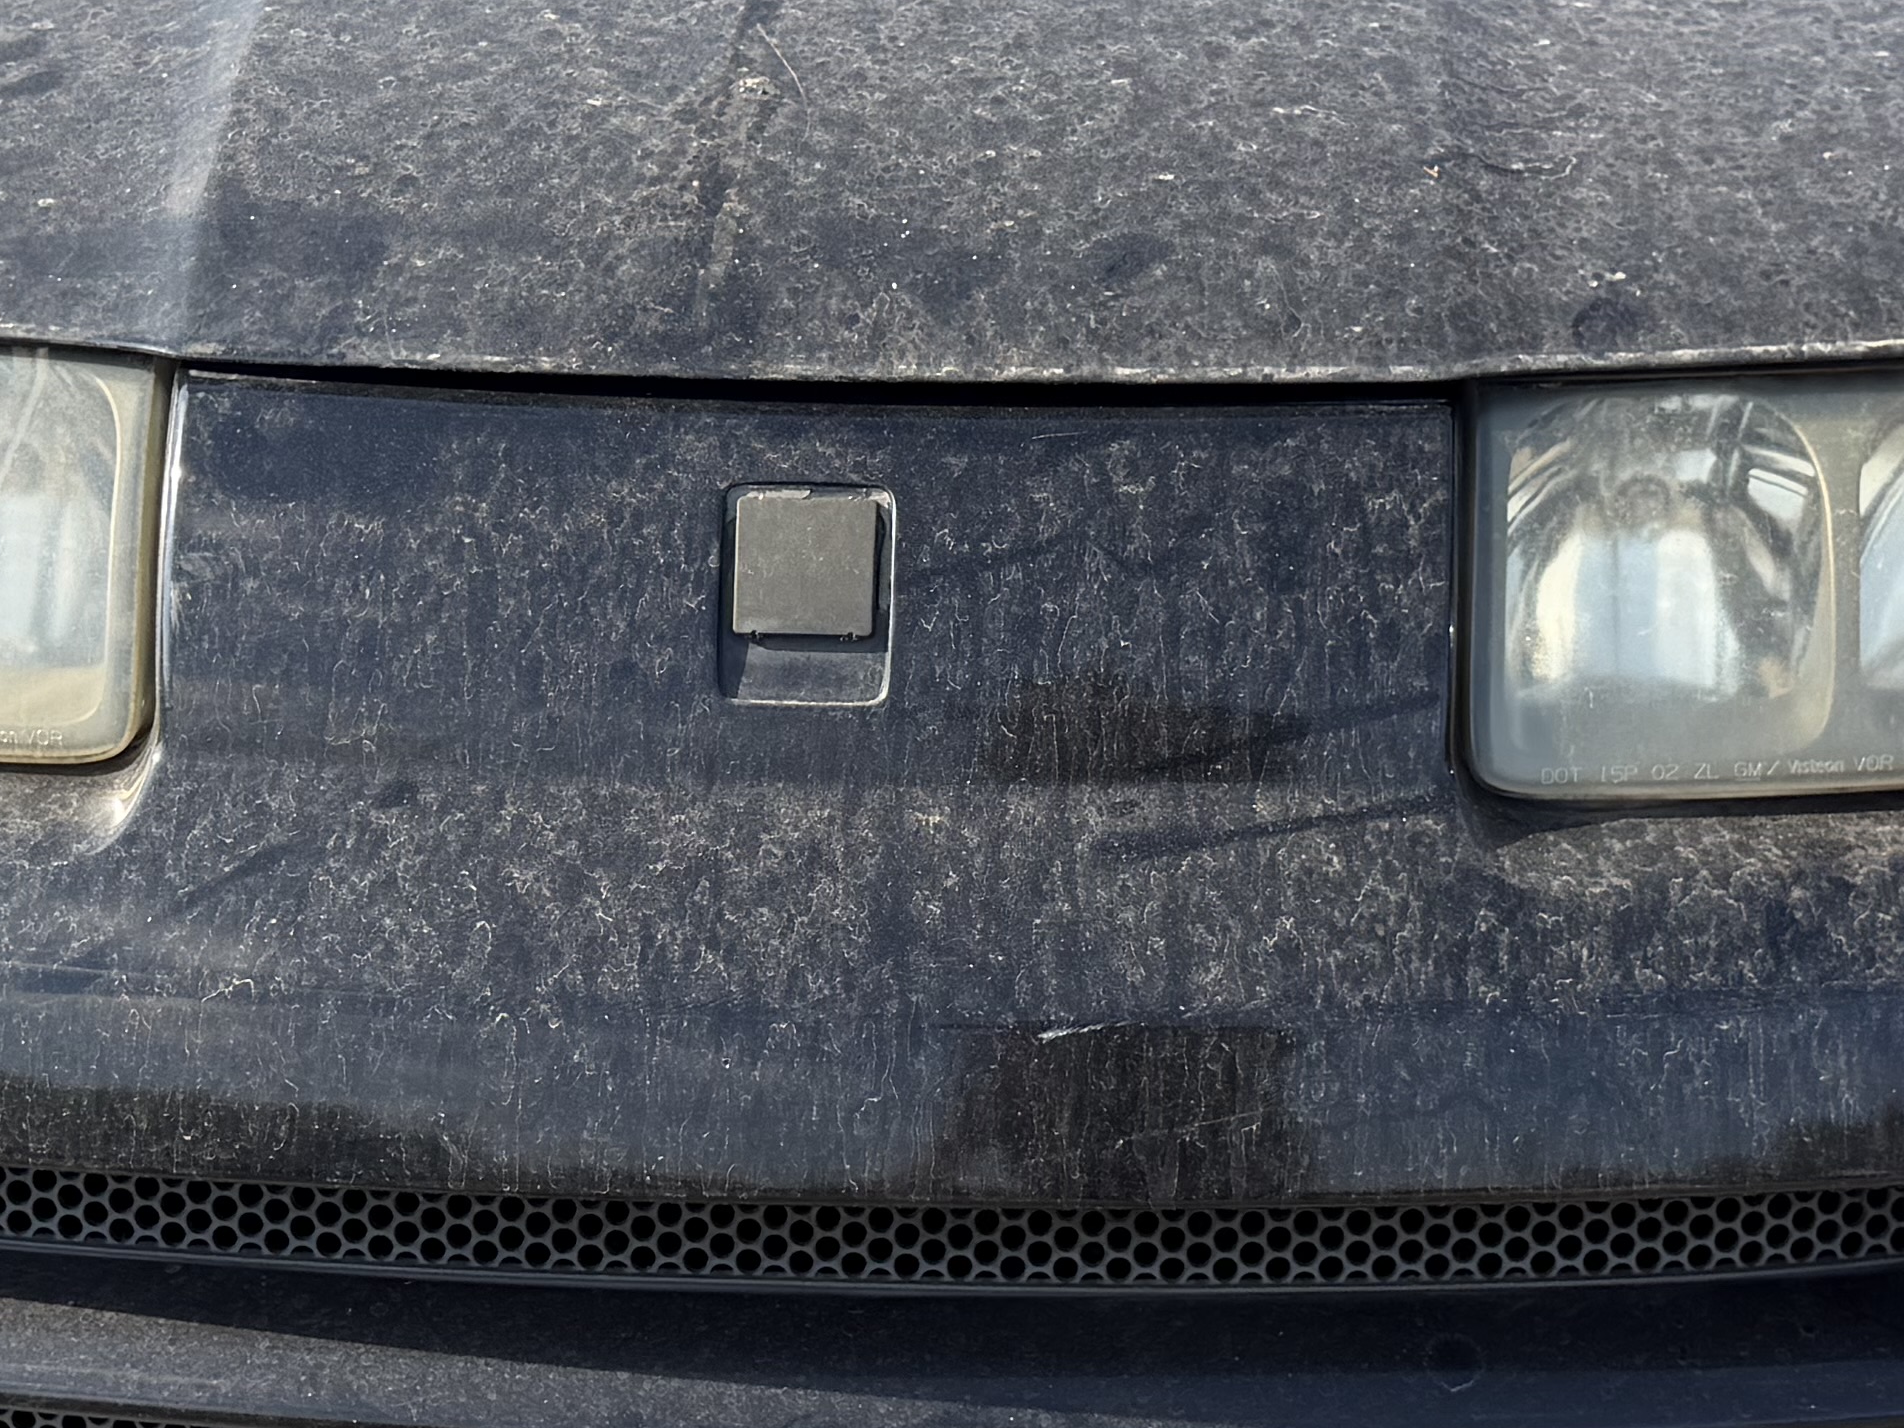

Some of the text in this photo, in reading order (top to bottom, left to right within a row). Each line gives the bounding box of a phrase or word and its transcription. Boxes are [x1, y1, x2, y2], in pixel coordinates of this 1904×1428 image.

[1541, 766, 1583, 785] DOT
[1651, 763, 1680, 781] 02
[1694, 762, 1720, 780] ZL
[1787, 758, 1845, 774] Visteon
[1853, 753, 1894, 772] VOR
